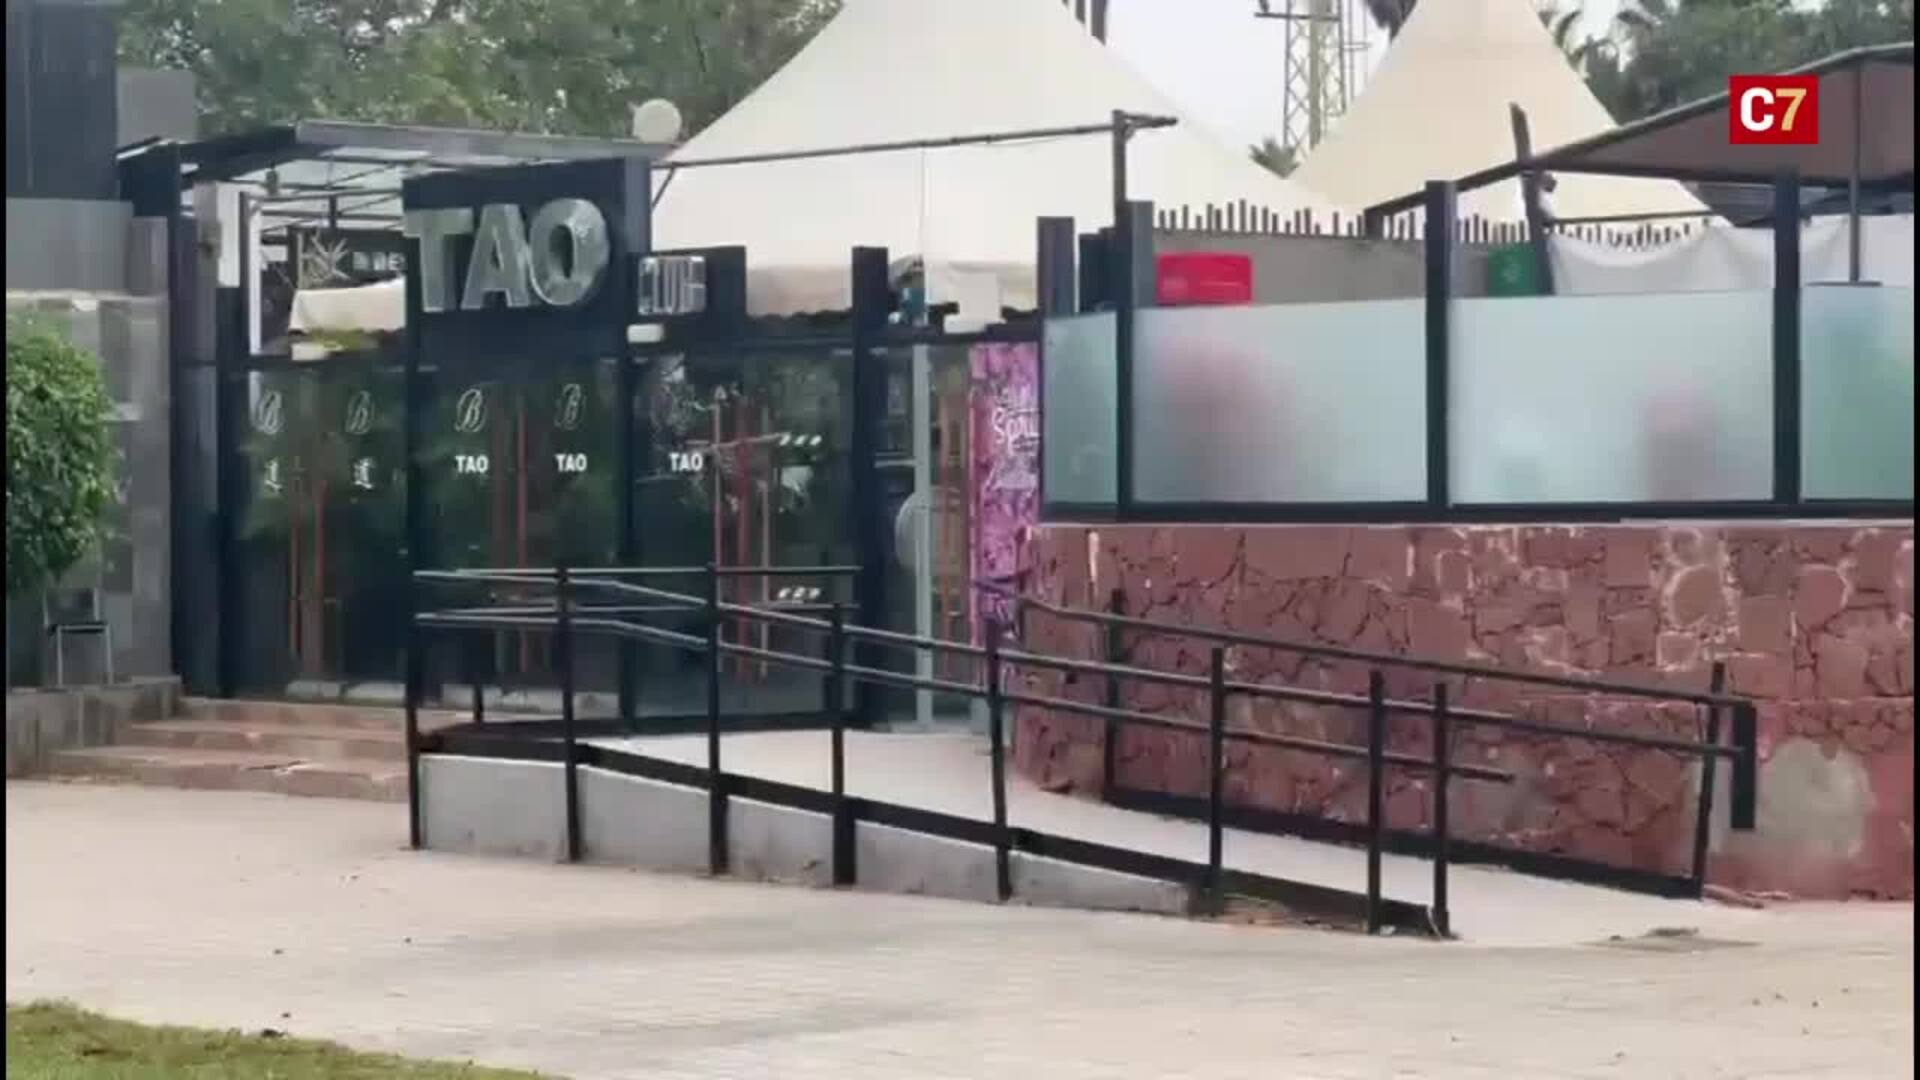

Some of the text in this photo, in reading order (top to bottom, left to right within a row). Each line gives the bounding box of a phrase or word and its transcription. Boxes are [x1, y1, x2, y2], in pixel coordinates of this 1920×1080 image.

[403, 198, 610, 313] TAO
[455, 454, 489, 473] TAO
[554, 453, 588, 472] TAO
[669, 453, 704, 472] TAO
